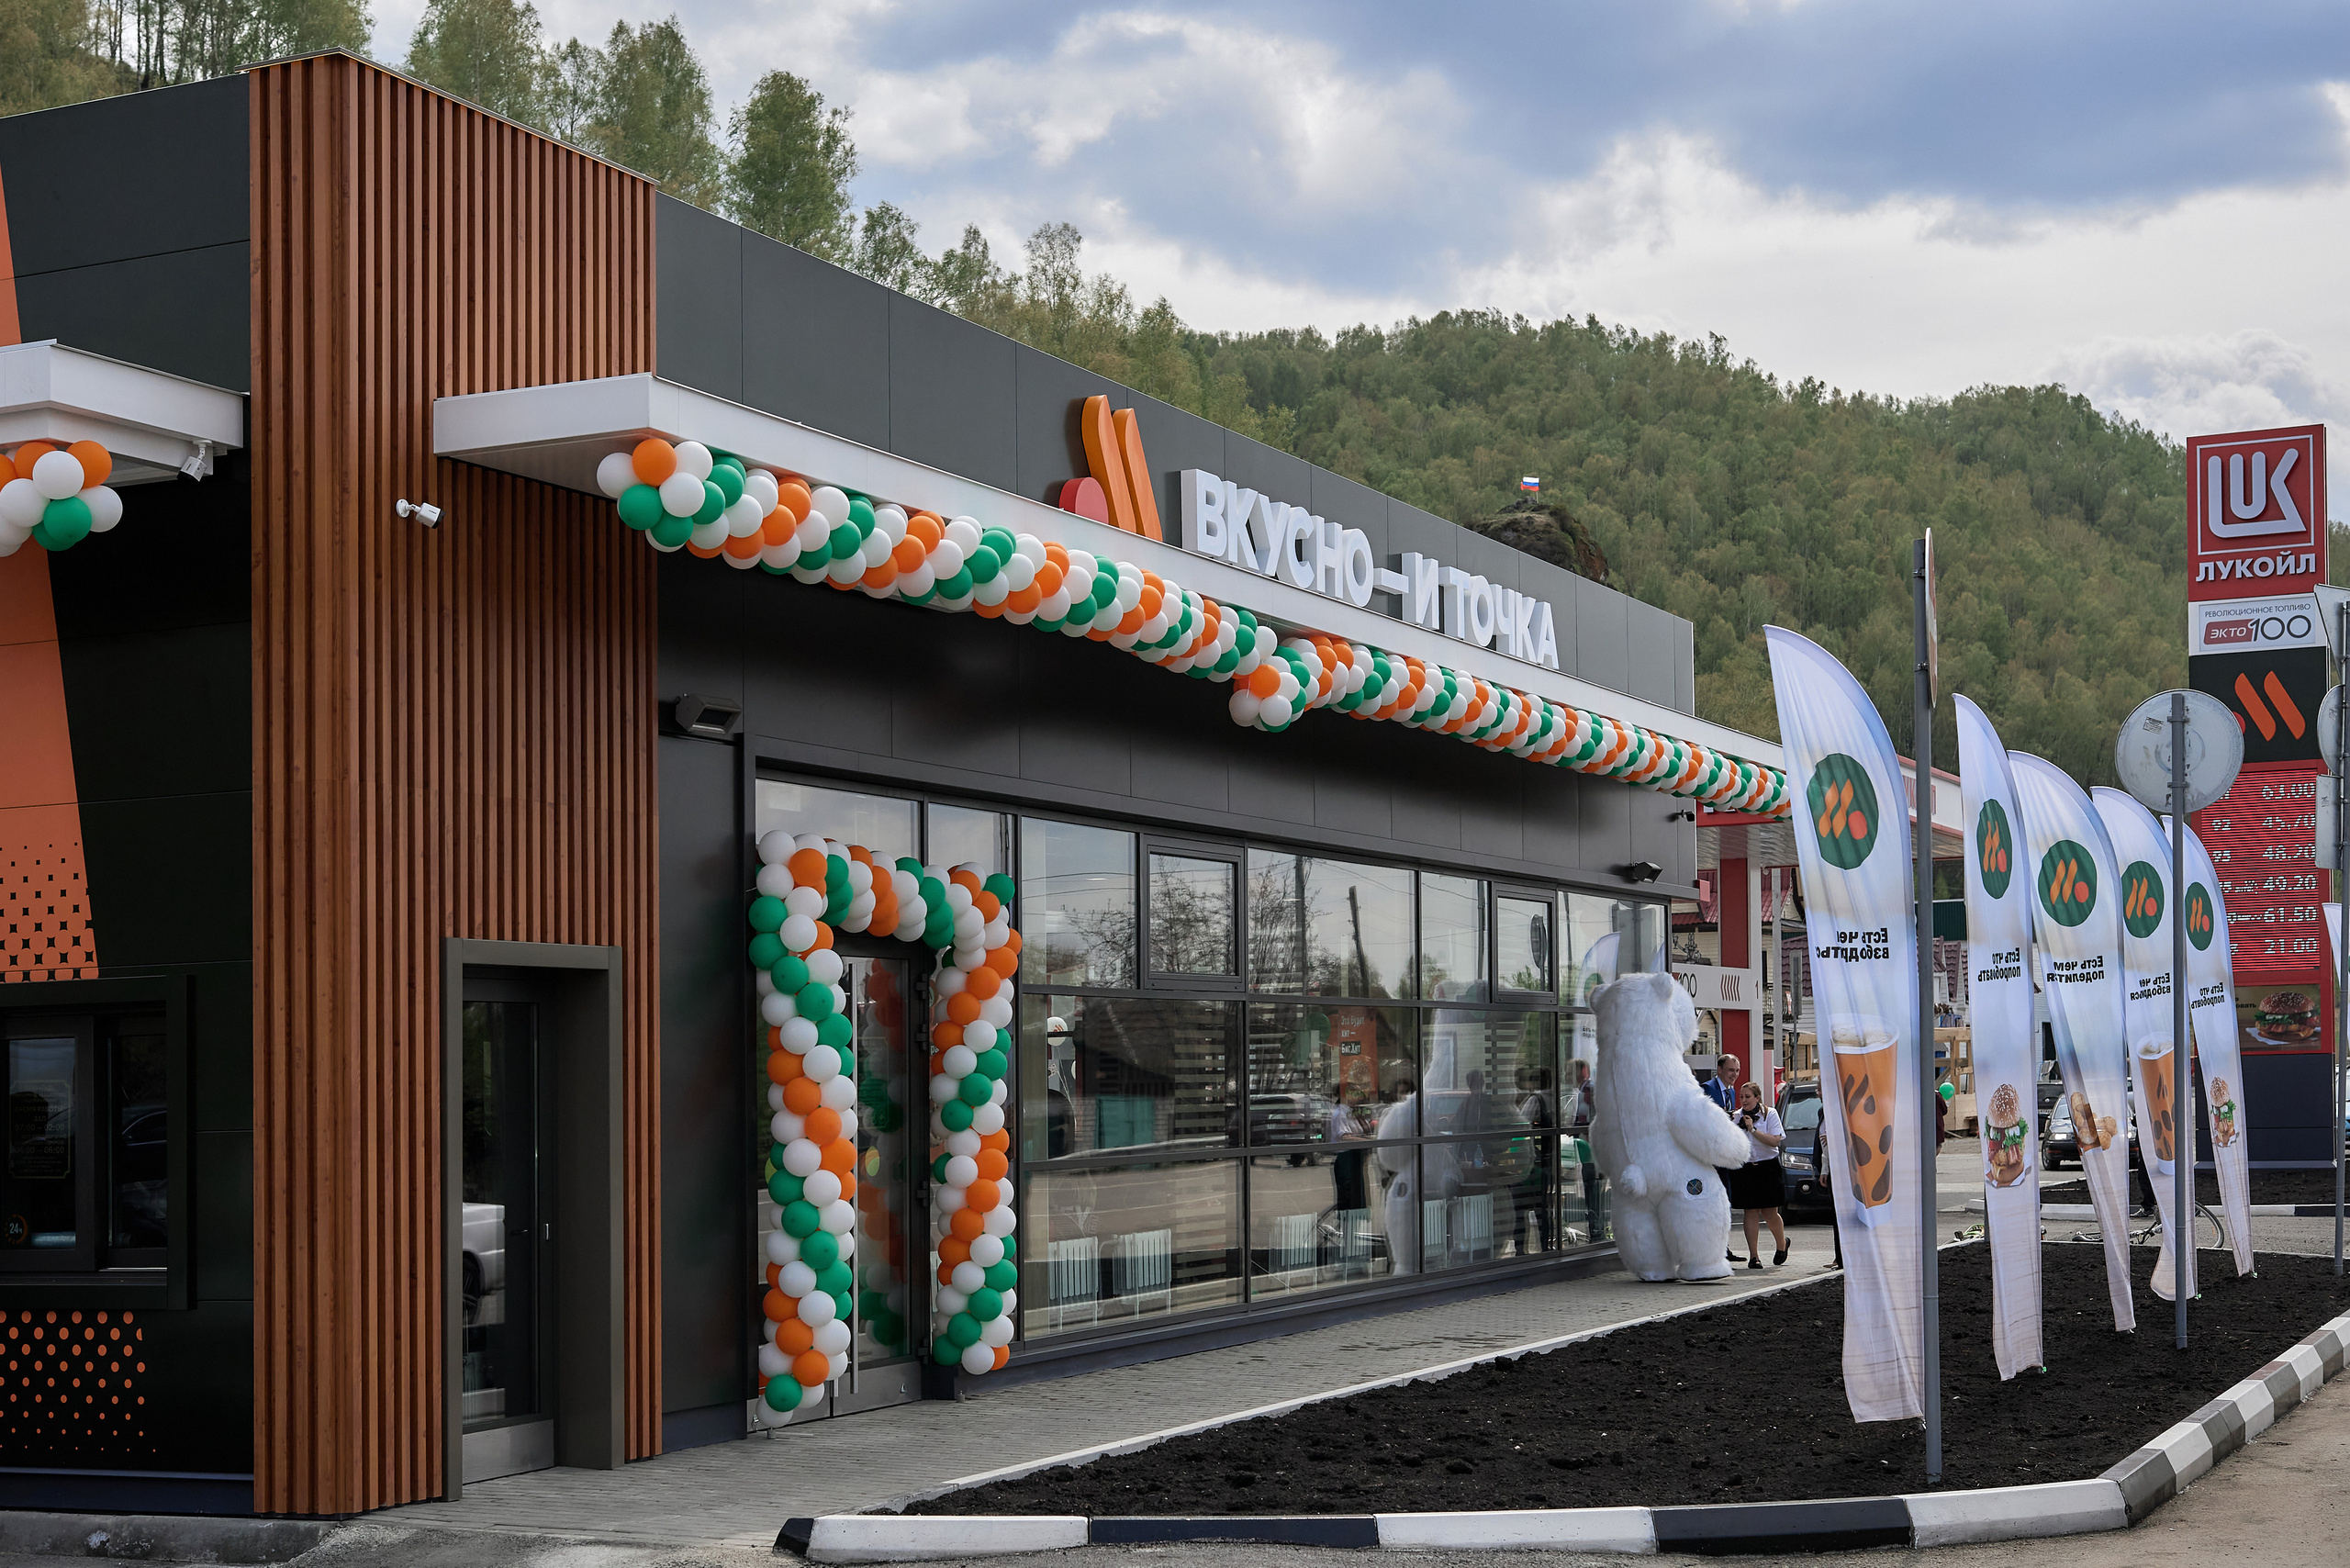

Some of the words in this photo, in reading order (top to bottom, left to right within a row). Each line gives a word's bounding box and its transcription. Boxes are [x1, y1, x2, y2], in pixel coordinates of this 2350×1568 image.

[1181, 468, 1373, 608] ВКУСНО
[1438, 566, 1560, 670] ТОЧКА
[2195, 551, 2317, 583] ЛУКОЙЛ
[2205, 607, 2273, 618] РЕВОЛЮЦИОННОЕ
[2275, 603, 2311, 612] ТОПЛИВО
